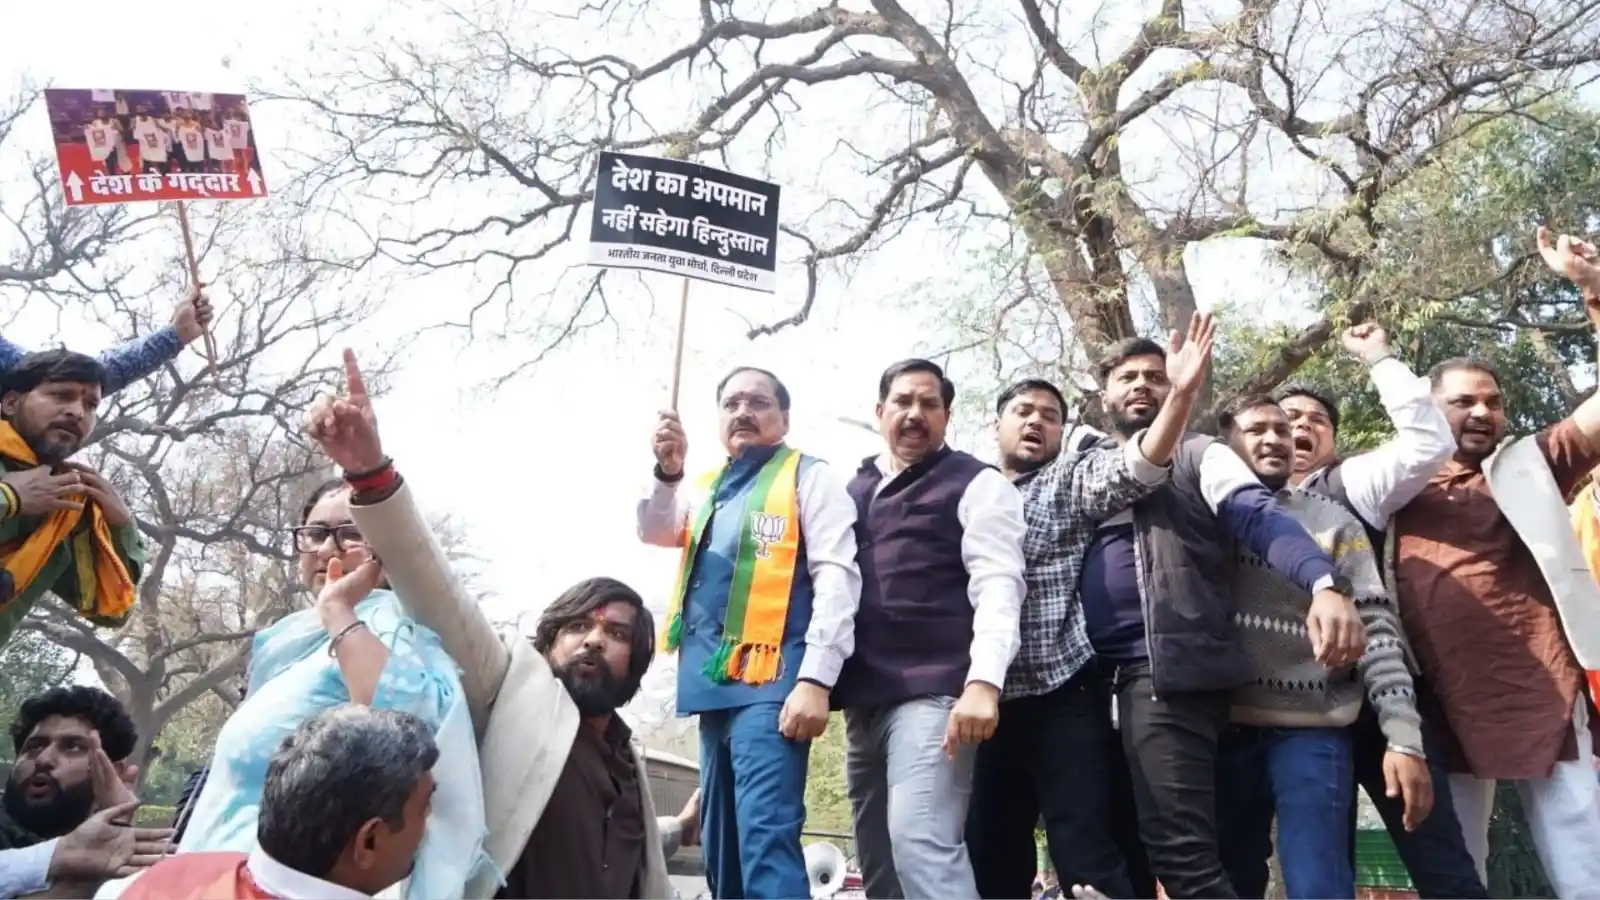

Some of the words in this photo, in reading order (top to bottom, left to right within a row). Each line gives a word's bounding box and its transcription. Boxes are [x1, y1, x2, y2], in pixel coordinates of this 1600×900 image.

[90, 169, 133, 195] देश
[134, 168, 164, 194] के
[611, 159, 652, 192] देश
[655, 171, 688, 197] का
[691, 178, 768, 217] अपमान
[602, 204, 640, 232] नहीं
[639, 208, 690, 237] सहेगा
[692, 216, 769, 256] हिन्दुस्तान
[608, 247, 640, 260] भारतीय
[641, 253, 667, 264] जनता
[668, 255, 686, 269] युवा
[710, 261, 736, 278] दिल्ली
[737, 268, 758, 283] प्रदेश
